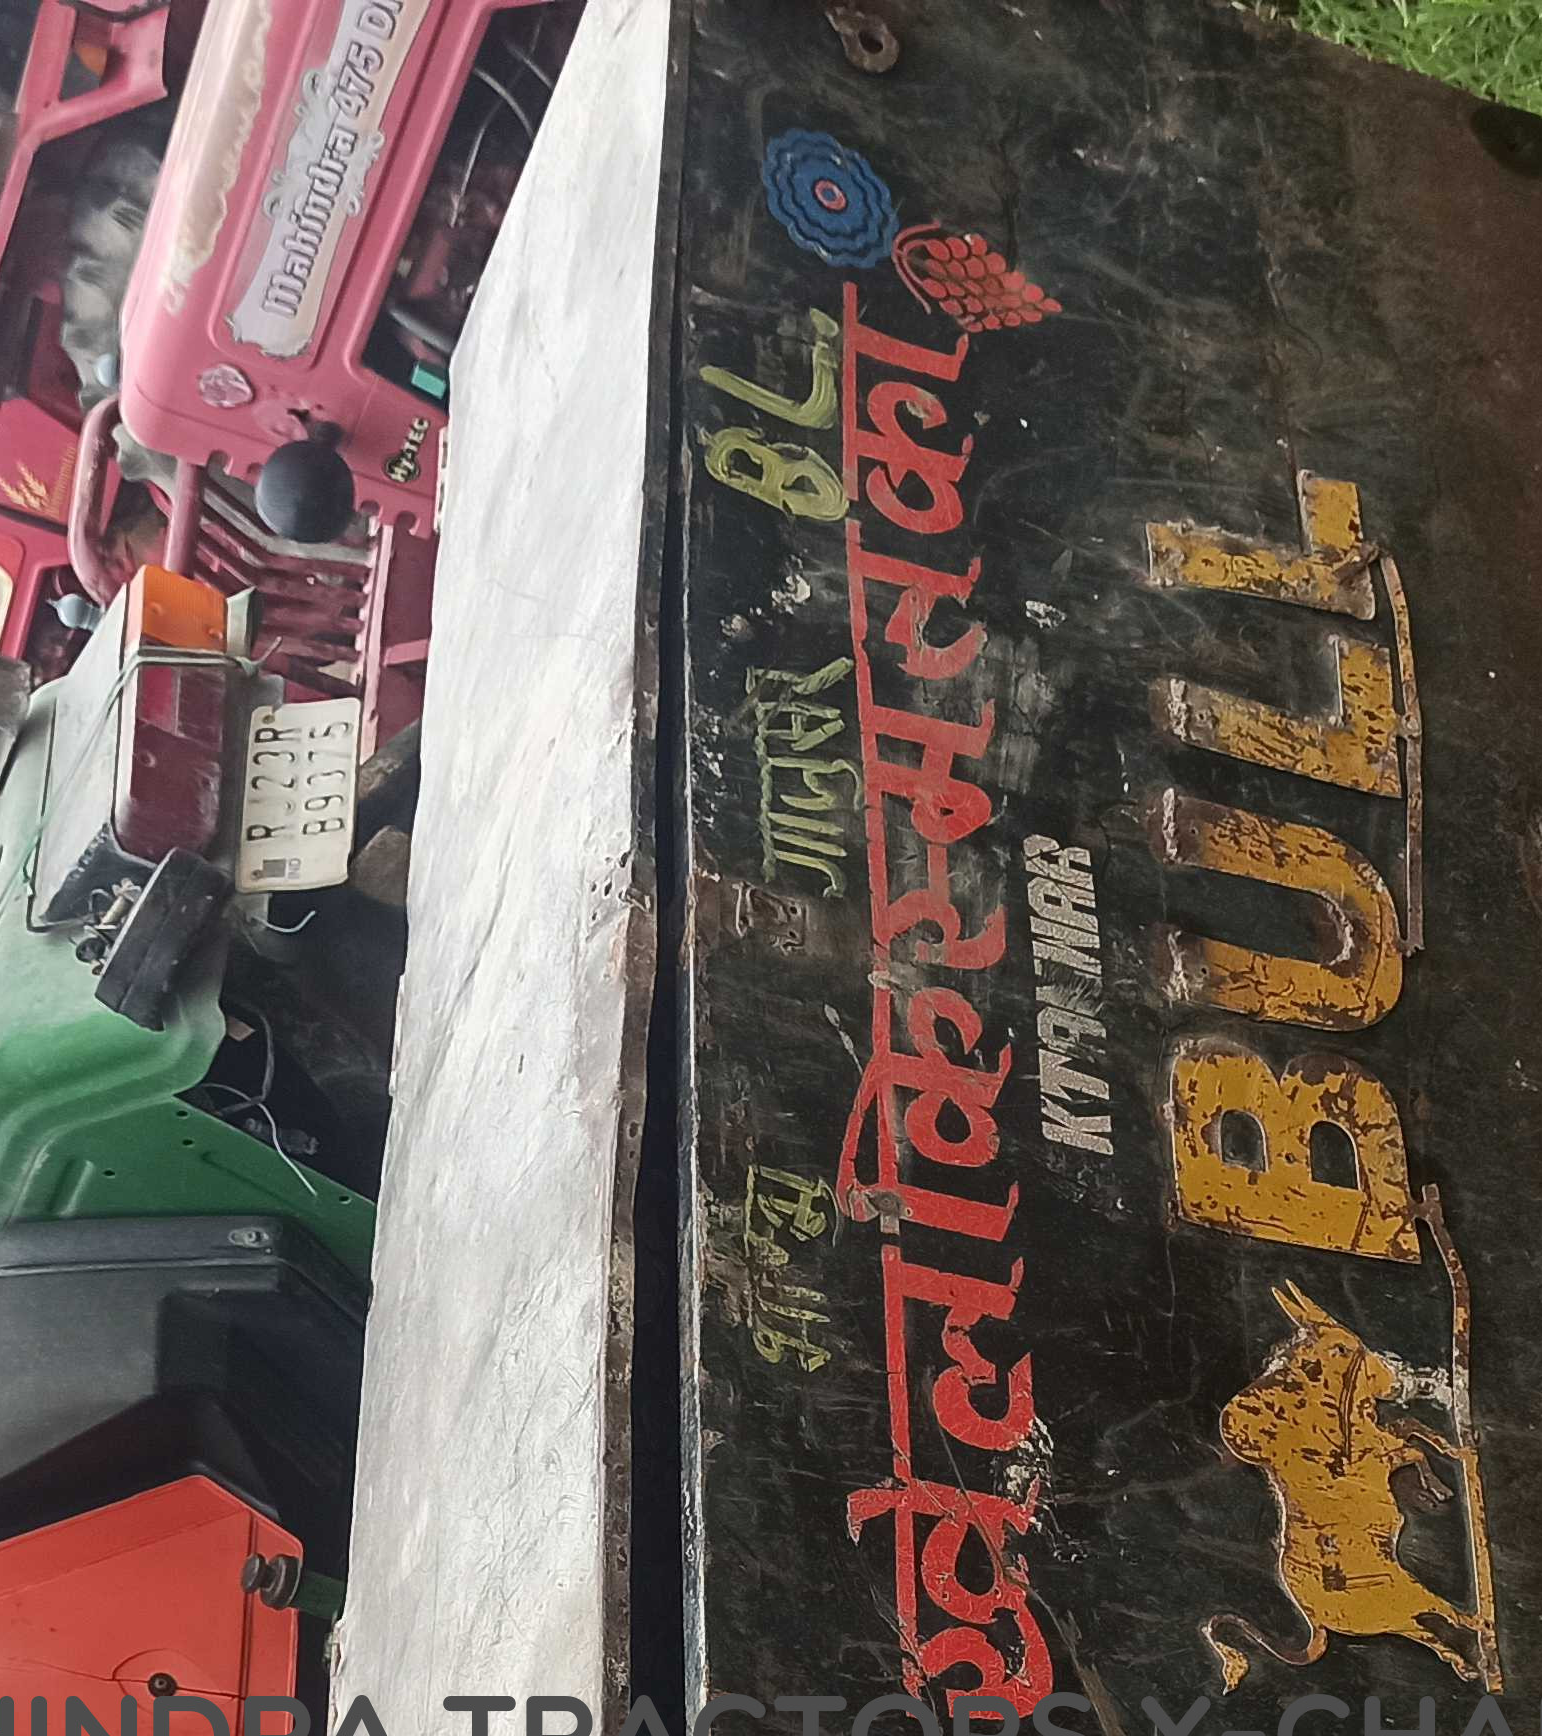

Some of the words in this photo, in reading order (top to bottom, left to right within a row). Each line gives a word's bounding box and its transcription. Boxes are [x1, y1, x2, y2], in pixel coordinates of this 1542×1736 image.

[259, 126, 359, 318] Mahindra
[326, 40, 385, 118] 475
[839, 280, 975, 534] का
[1143, 469, 1425, 1266] BULL
[845, 1244, 1055, 1720] खेल
